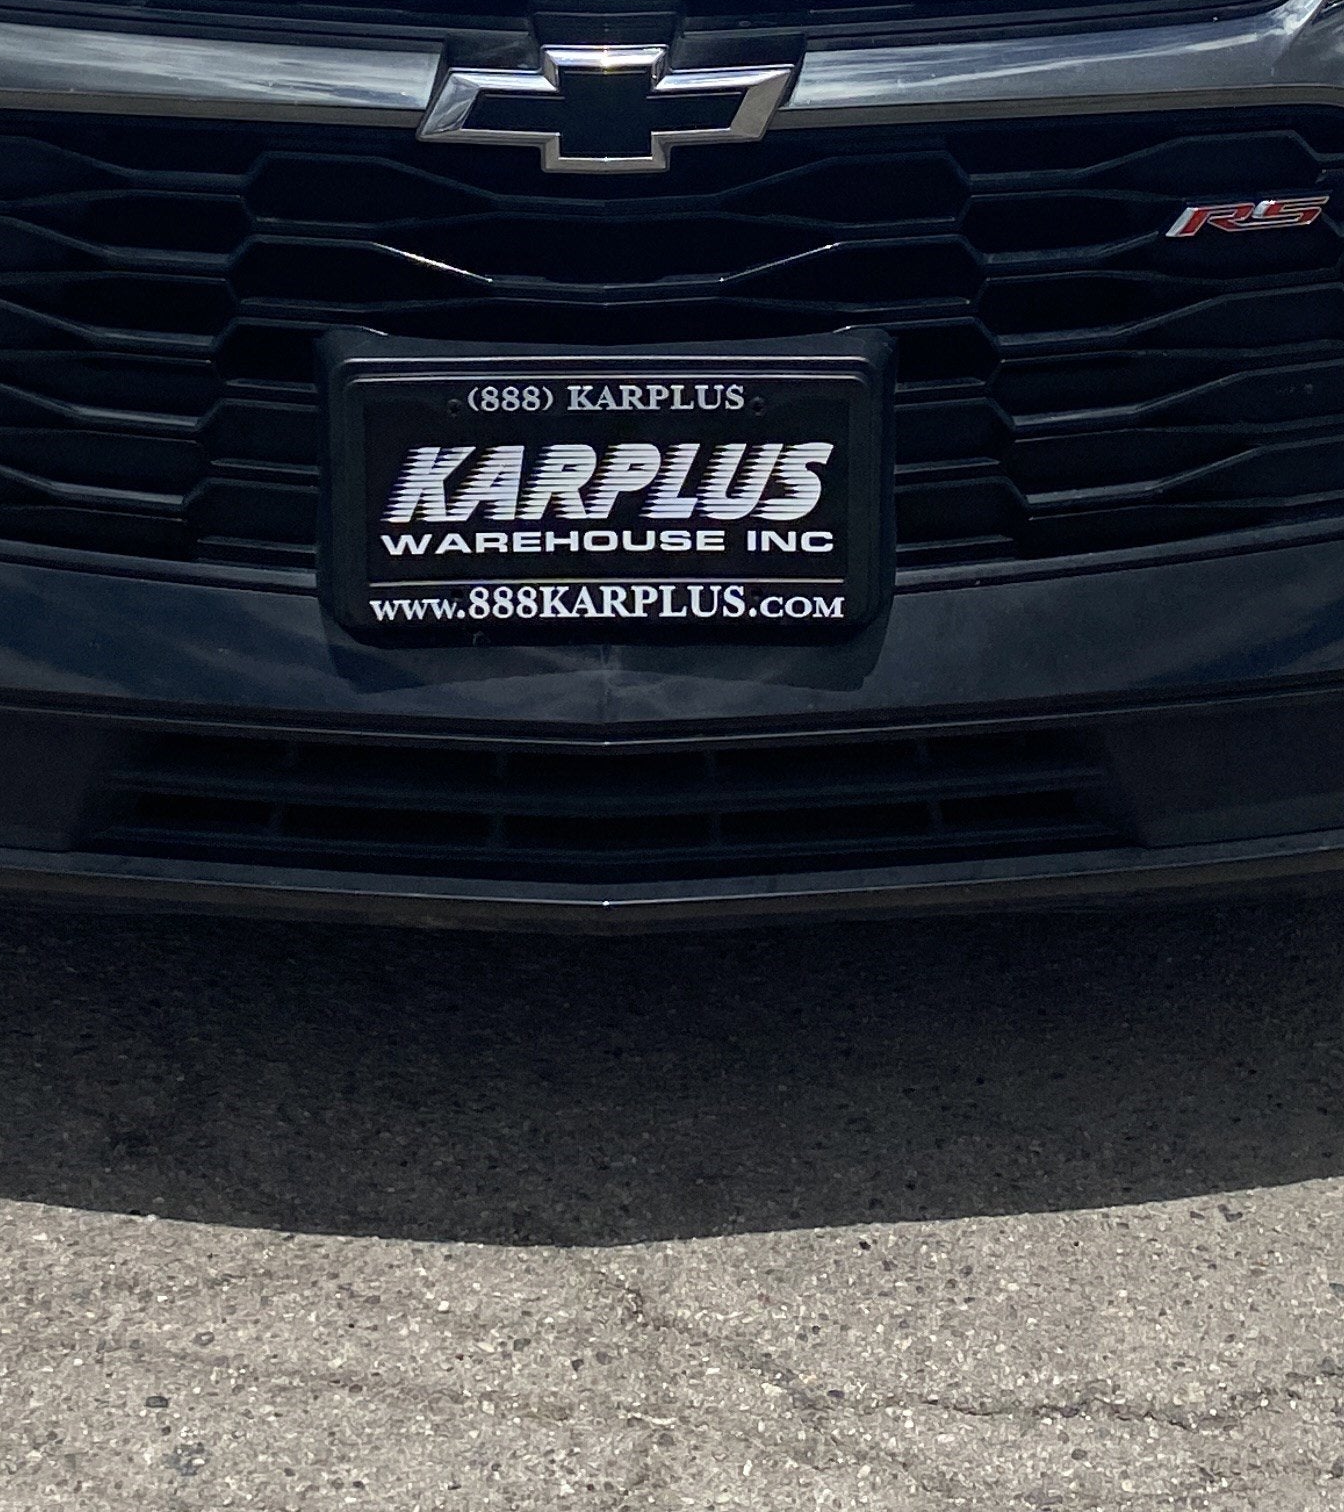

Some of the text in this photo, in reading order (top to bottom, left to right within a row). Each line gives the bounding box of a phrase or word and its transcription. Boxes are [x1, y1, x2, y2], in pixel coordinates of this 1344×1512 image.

[1165, 195, 1330, 238] RS
[467, 384, 745, 413] (888) KARPLUS
[379, 441, 834, 523] KARPLUS
[381, 529, 834, 556] WAREHOUSE INC
